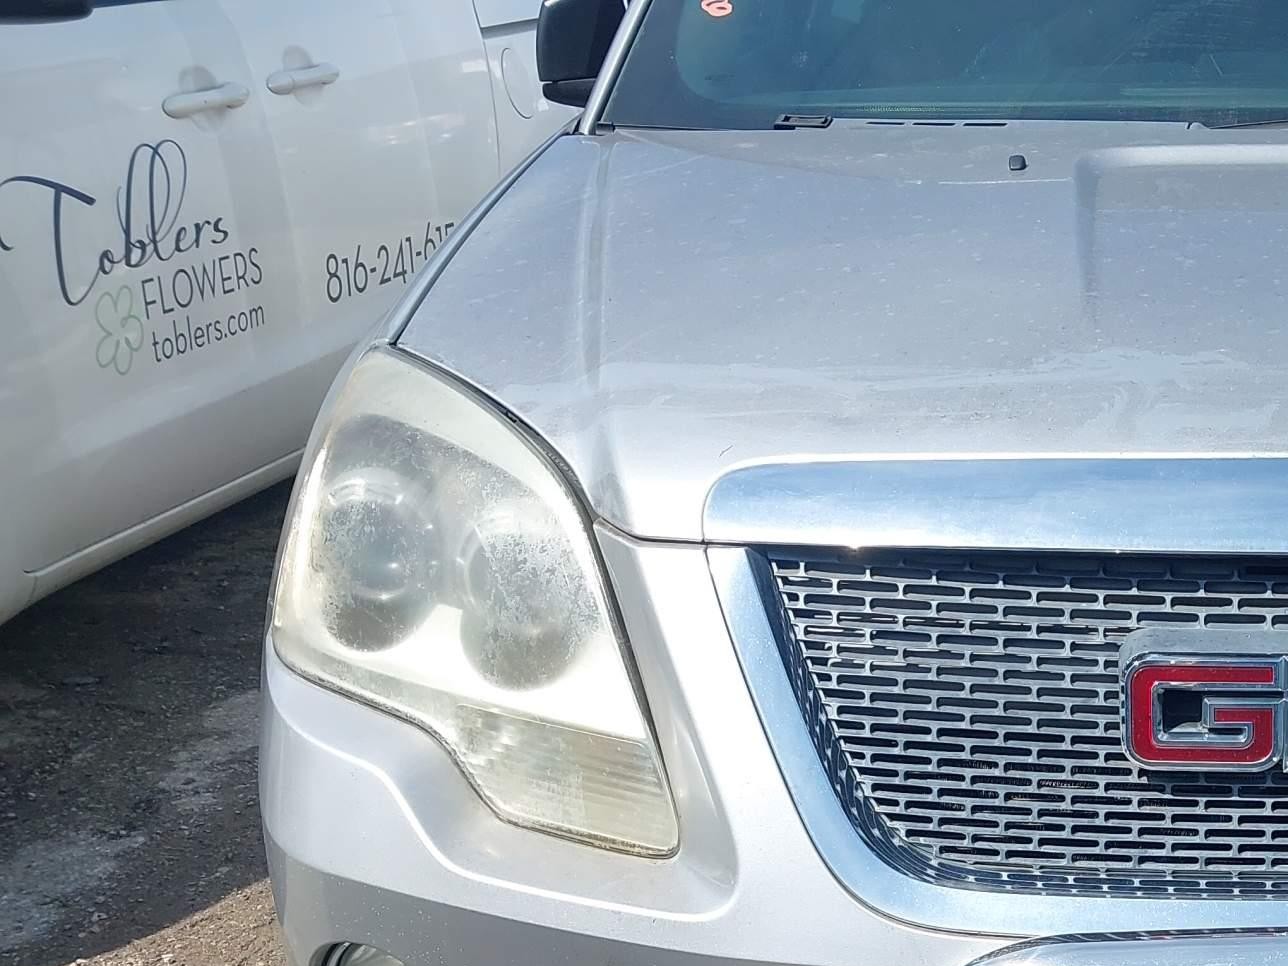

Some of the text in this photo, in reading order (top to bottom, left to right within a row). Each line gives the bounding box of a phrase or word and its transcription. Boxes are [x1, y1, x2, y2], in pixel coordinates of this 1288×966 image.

[0, 139, 229, 306] Toblers
[141, 247, 263, 320] FLOWERS
[152, 305, 265, 362] toblers.com
